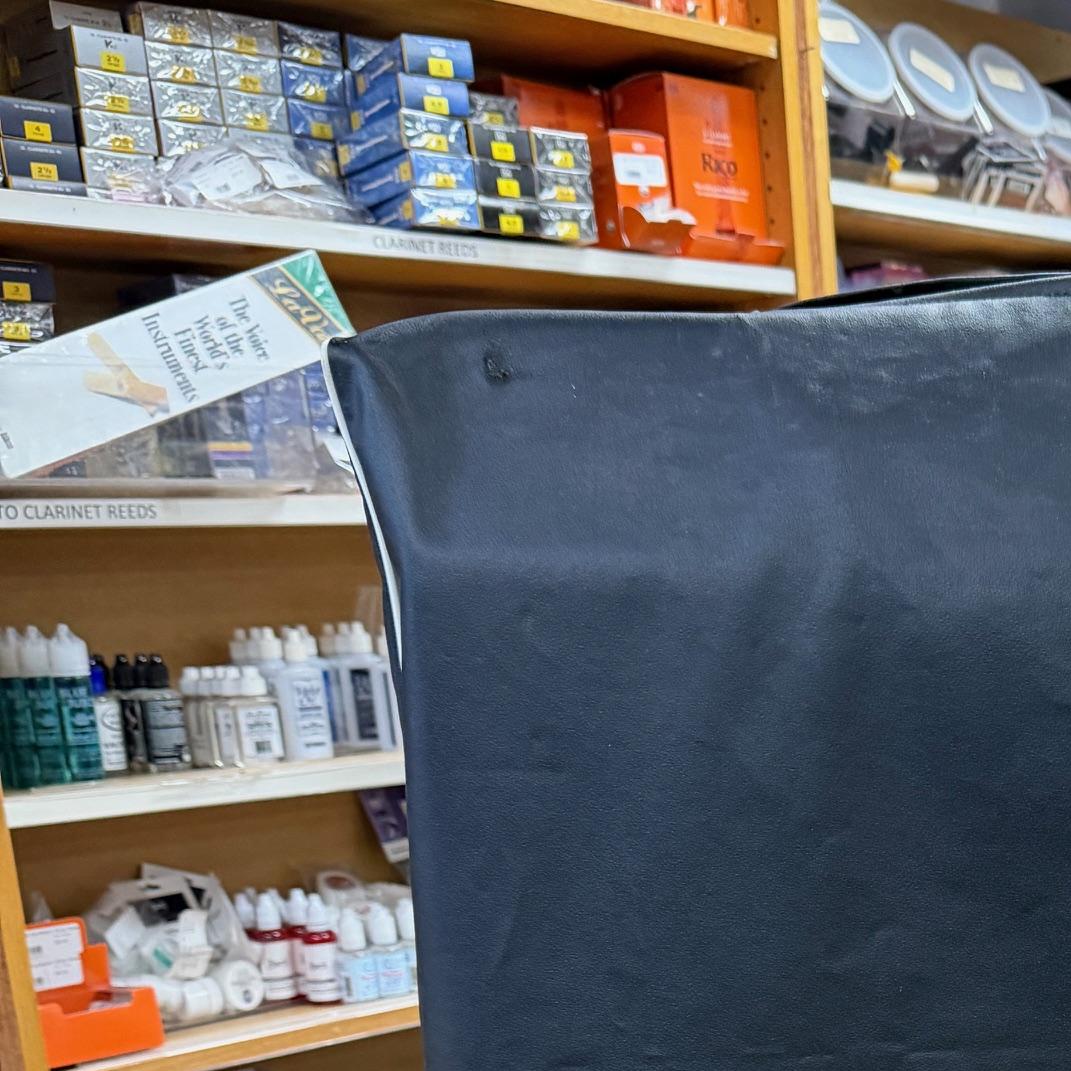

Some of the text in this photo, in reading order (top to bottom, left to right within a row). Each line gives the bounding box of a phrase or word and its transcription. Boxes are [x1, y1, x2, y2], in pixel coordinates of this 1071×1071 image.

[373, 236, 435, 254] CLARINET
[174, 327, 208, 374] Finest
[194, 315, 230, 370] World's
[215, 316, 245, 356] of the
[229, 295, 270, 361] The Voice
[141, 312, 200, 403] Instruments
[23, 504, 102, 520] CLARINET
[107, 504, 158, 520] REEDS
